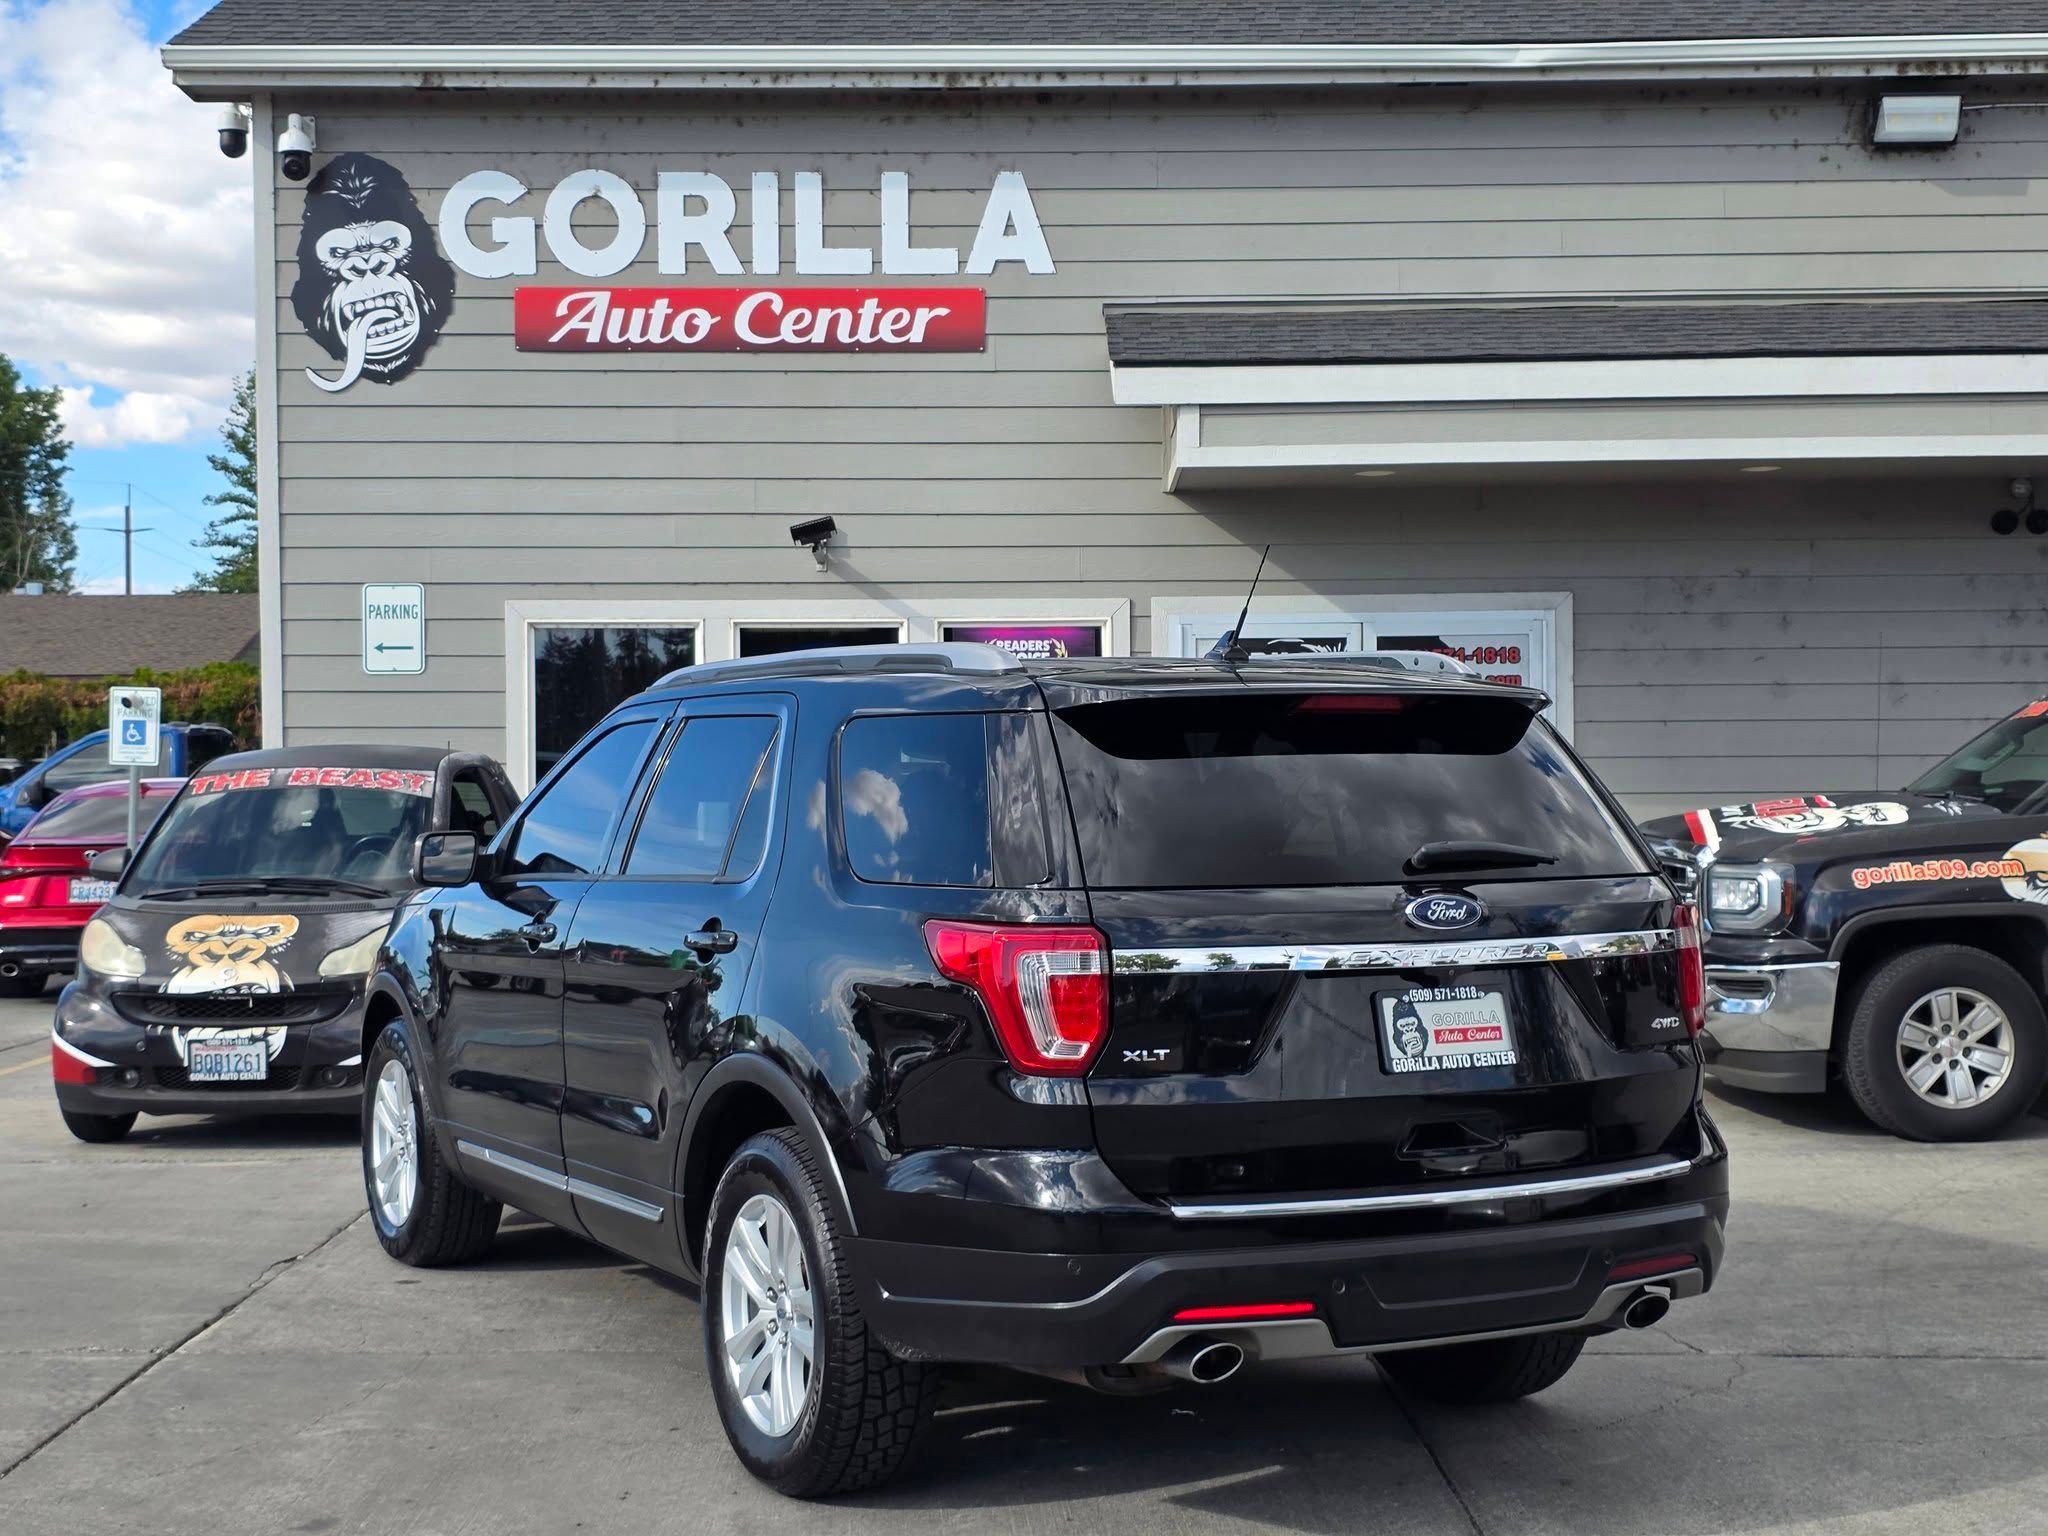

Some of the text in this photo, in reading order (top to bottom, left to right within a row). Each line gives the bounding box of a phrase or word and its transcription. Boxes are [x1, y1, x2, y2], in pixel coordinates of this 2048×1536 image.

[438, 169, 1057, 279] GORILLA
[548, 291, 951, 344] Auto Center
[368, 604, 419, 620] PARKING
[190, 768, 273, 795] THE
[288, 767, 433, 792] BEAST
[1852, 859, 2025, 889] gorilla509.com
[1427, 899, 1467, 921] Ford
[1409, 986, 1477, 1002] (509) 571-1818
[1432, 1010, 1500, 1026] GORILLA
[1651, 1016, 1680, 1029] 4WD
[1123, 1049, 1170, 1062] XLT
[1393, 1051, 1516, 1073] GORILLA AUTO CENTER
